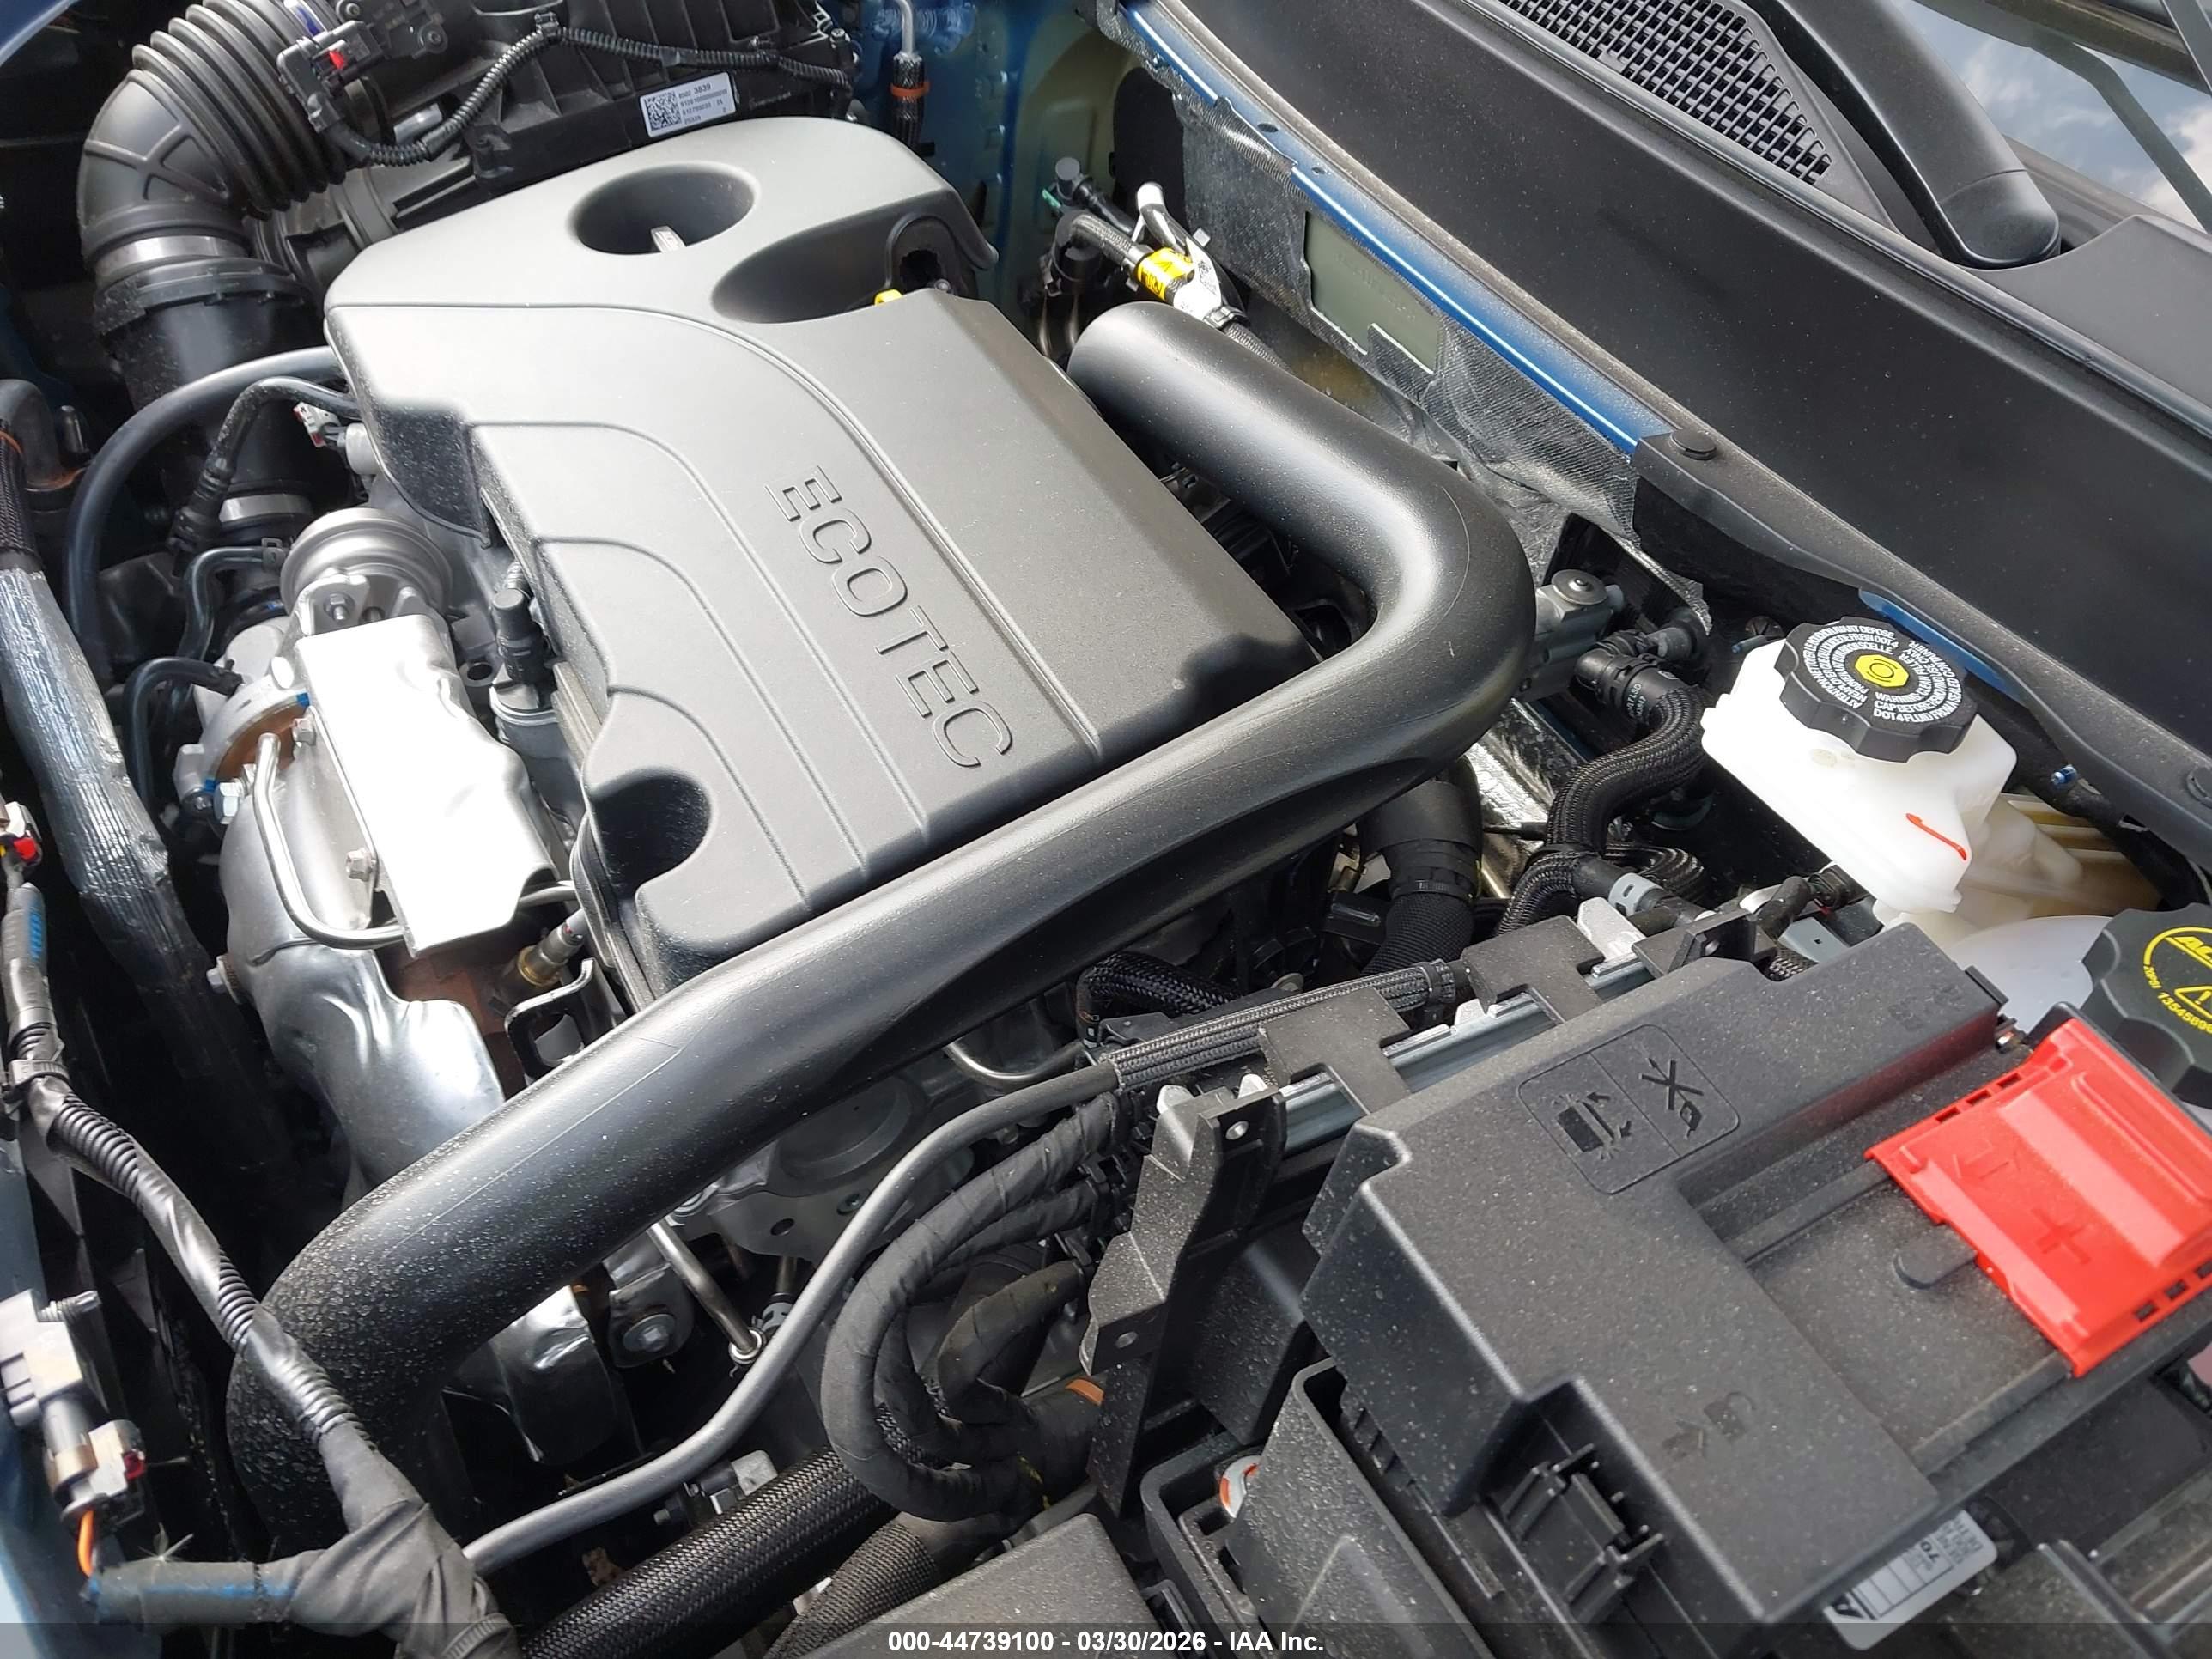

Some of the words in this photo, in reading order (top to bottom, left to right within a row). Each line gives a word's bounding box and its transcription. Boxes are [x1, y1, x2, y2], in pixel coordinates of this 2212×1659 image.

[764, 465, 1013, 769] ECOTEC
[1817, 657, 1832, 669] QUE
[1874, 635, 1890, 645] DOT
[1889, 640, 1899, 648] 4
[1903, 648, 1929, 663] ONLY
[1803, 650, 1824, 678] NETTOYER
[1899, 653, 1928, 675] FILLER
[1923, 664, 1942, 677] USE
[1832, 661, 1869, 693] PROVENANT
[1916, 676, 1931, 696] CLEAN
[1873, 708, 1895, 720] DOT
[1894, 713, 1905, 721] 4
[1903, 713, 1934, 722] FLUID
[1929, 704, 1955, 719] FROM
[1947, 678, 1961, 702] SEALED
[1874, 701, 1896, 711] CAP
[1896, 701, 1935, 712] BEFORE
